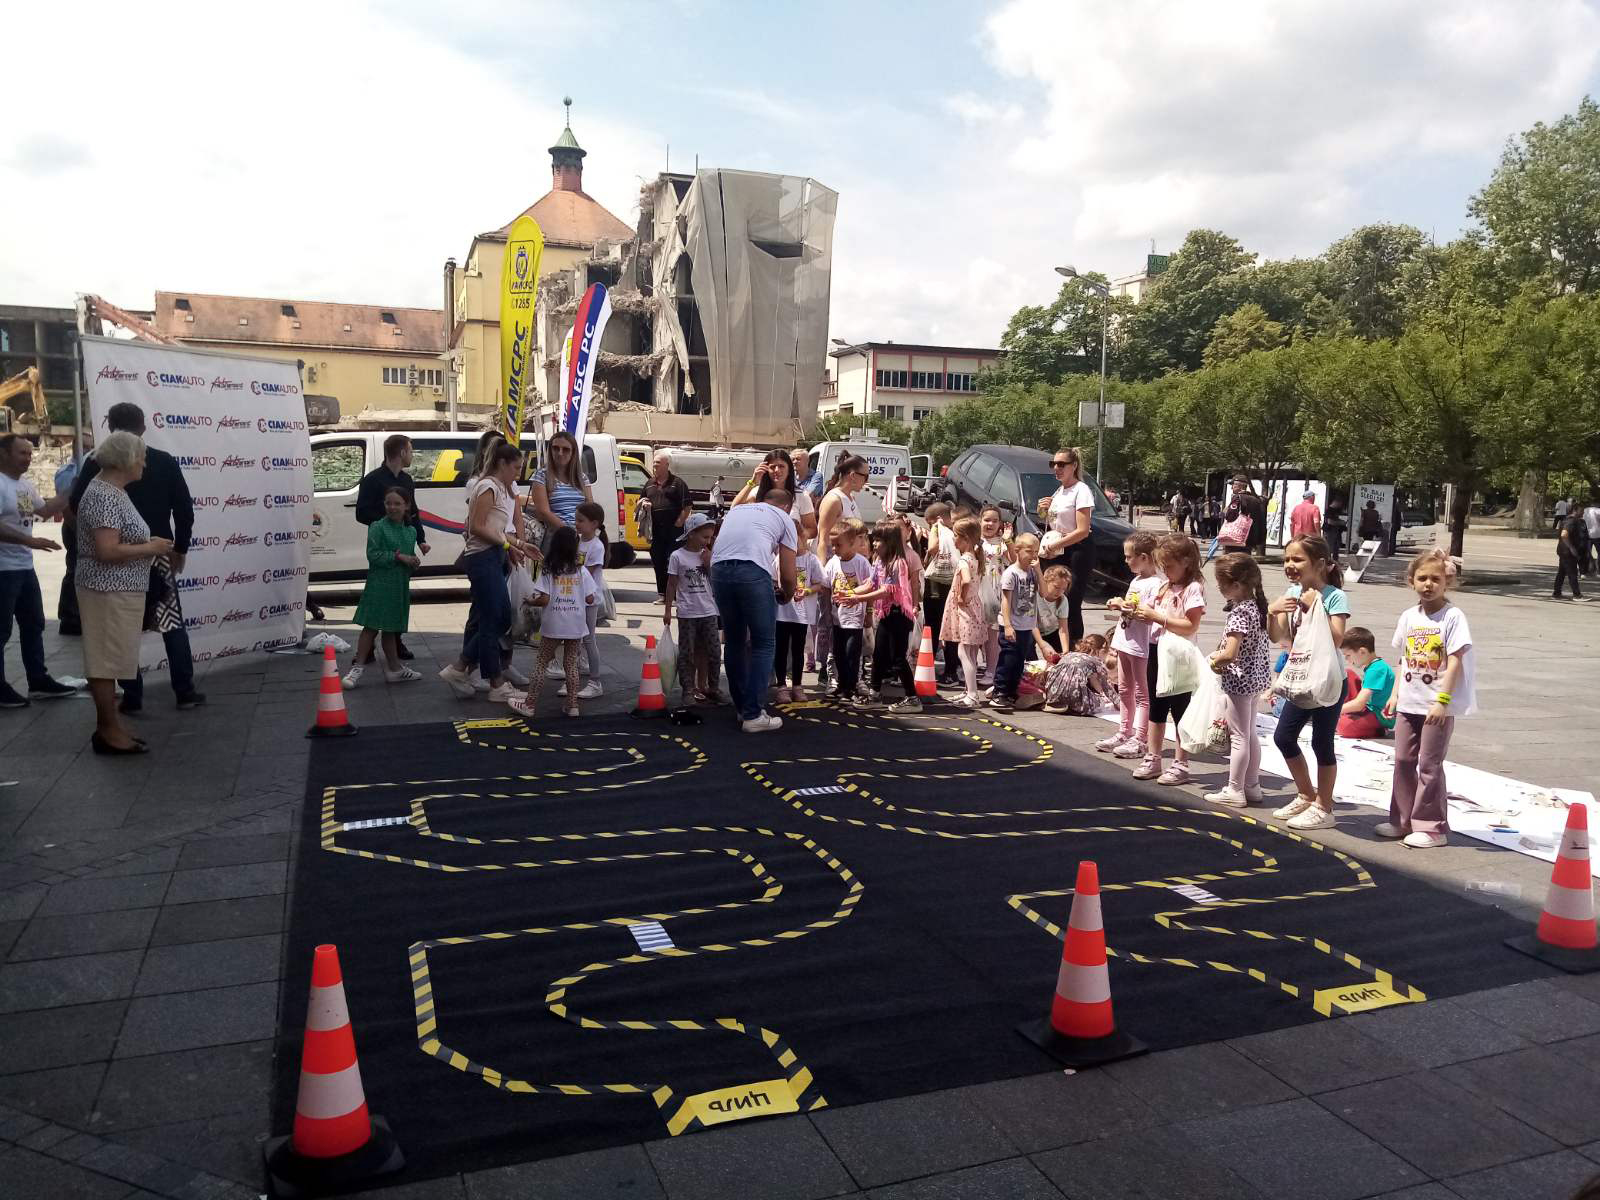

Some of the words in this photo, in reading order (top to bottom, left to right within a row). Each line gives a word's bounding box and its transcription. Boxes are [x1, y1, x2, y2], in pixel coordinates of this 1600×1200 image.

[173, 456, 216, 467] IAKAUTO
[868, 466, 885, 475] 285
[184, 615, 218, 627] AKAUTO
